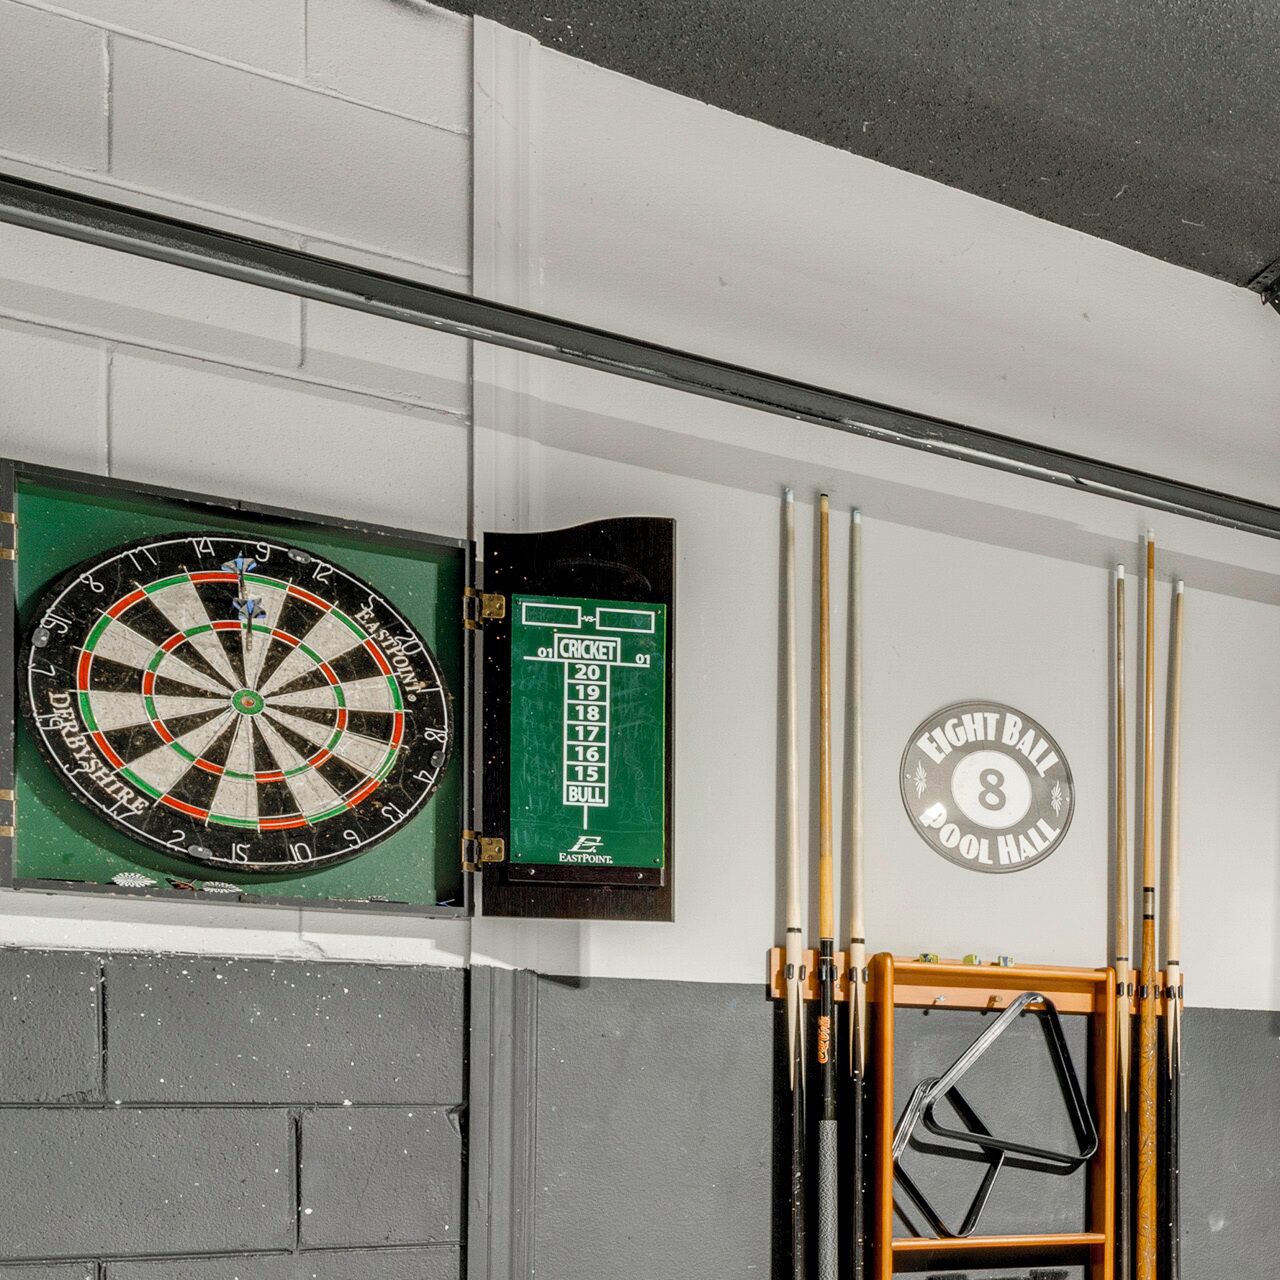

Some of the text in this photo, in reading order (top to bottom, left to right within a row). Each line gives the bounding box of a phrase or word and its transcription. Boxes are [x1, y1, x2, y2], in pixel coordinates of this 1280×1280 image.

[186, 537, 216, 558] 14
[80, 573, 104, 593] 8
[537, 647, 553, 658] 01
[559, 638, 617, 661] CRICKET
[635, 653, 650, 665] 01
[574, 664, 600, 680] 20
[575, 685, 600, 700] 19
[575, 705, 600, 721] 18
[575, 725, 600, 742] 17
[49, 691, 149, 815] DERBYSHIRE
[574, 746, 600, 762] 16
[916, 712, 1059, 778] EIGHT BALL
[574, 766, 599, 782] 15
[568, 786, 603, 803] BULL
[978, 768, 1007, 811] 8
[166, 830, 186, 850] 2
[918, 801, 1060, 865] POOL HALL
[231, 843, 250, 863] 15
[290, 843, 312, 863] 10
